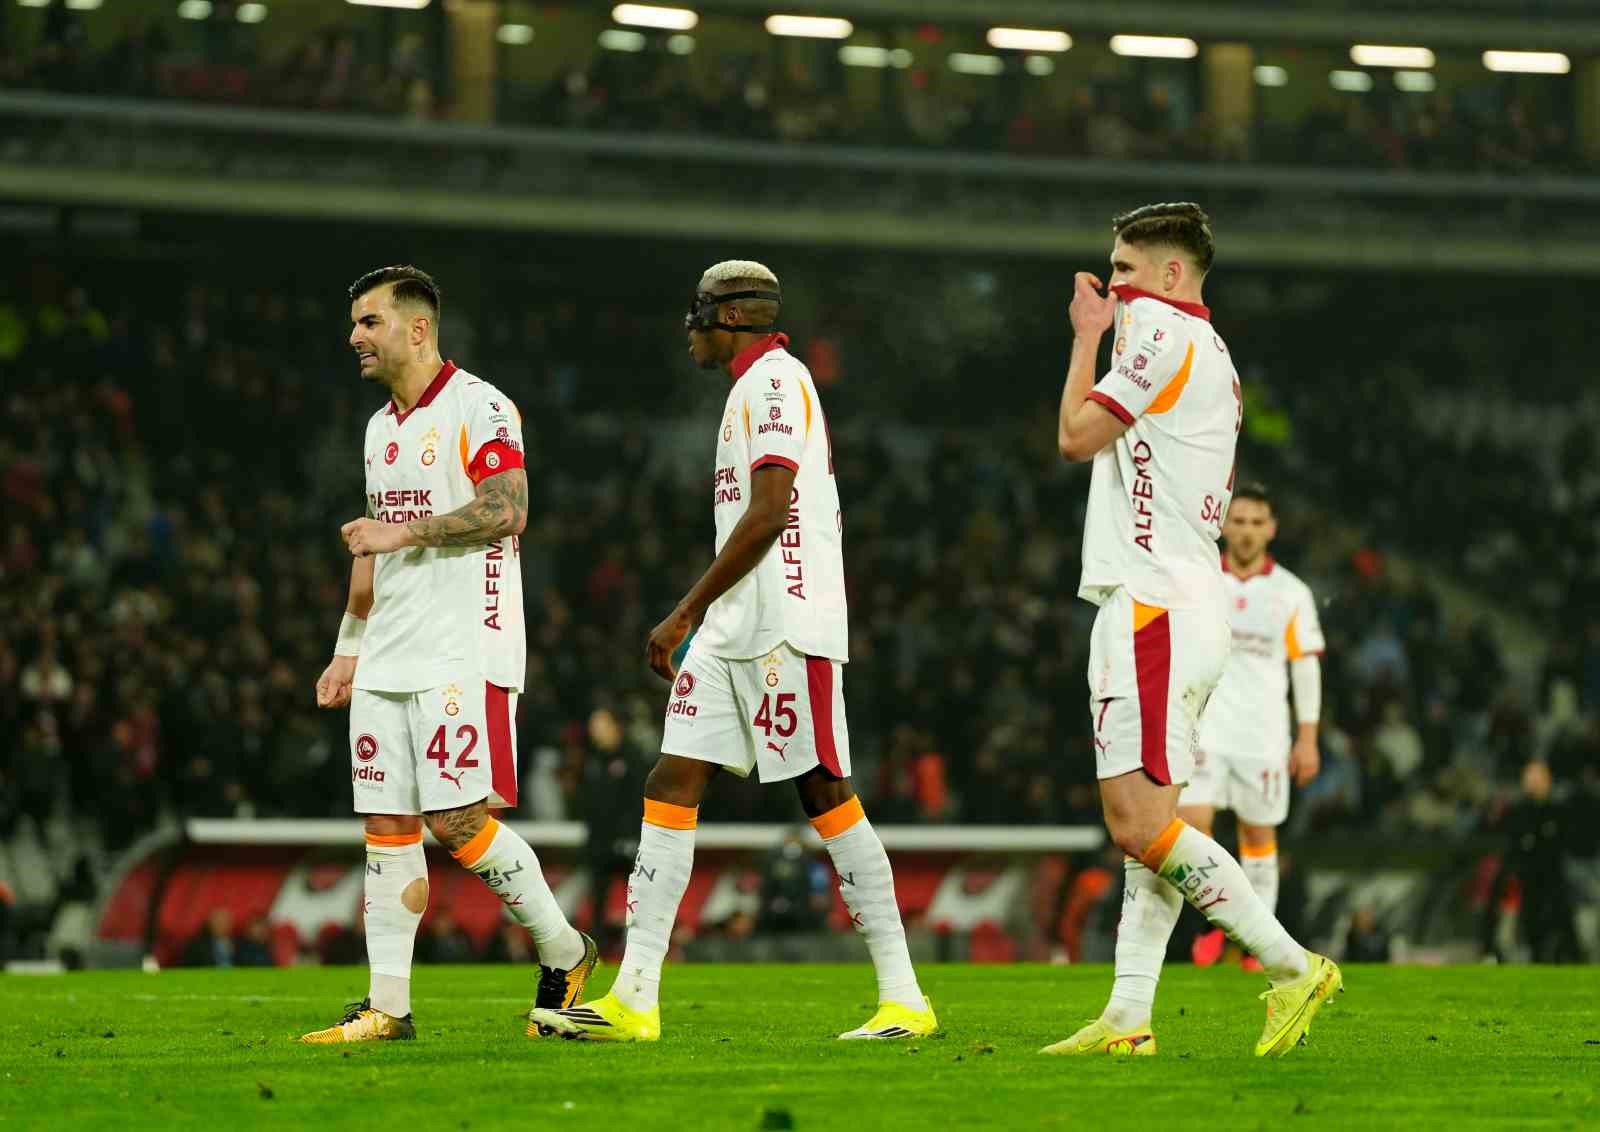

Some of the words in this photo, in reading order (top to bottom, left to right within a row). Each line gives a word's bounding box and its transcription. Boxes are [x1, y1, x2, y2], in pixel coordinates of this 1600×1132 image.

[484, 538, 504, 631] ALFEM
[666, 699, 698, 718] ydia
[753, 693, 798, 738] 45
[426, 724, 479, 769] 42
[351, 766, 385, 782] ydia
